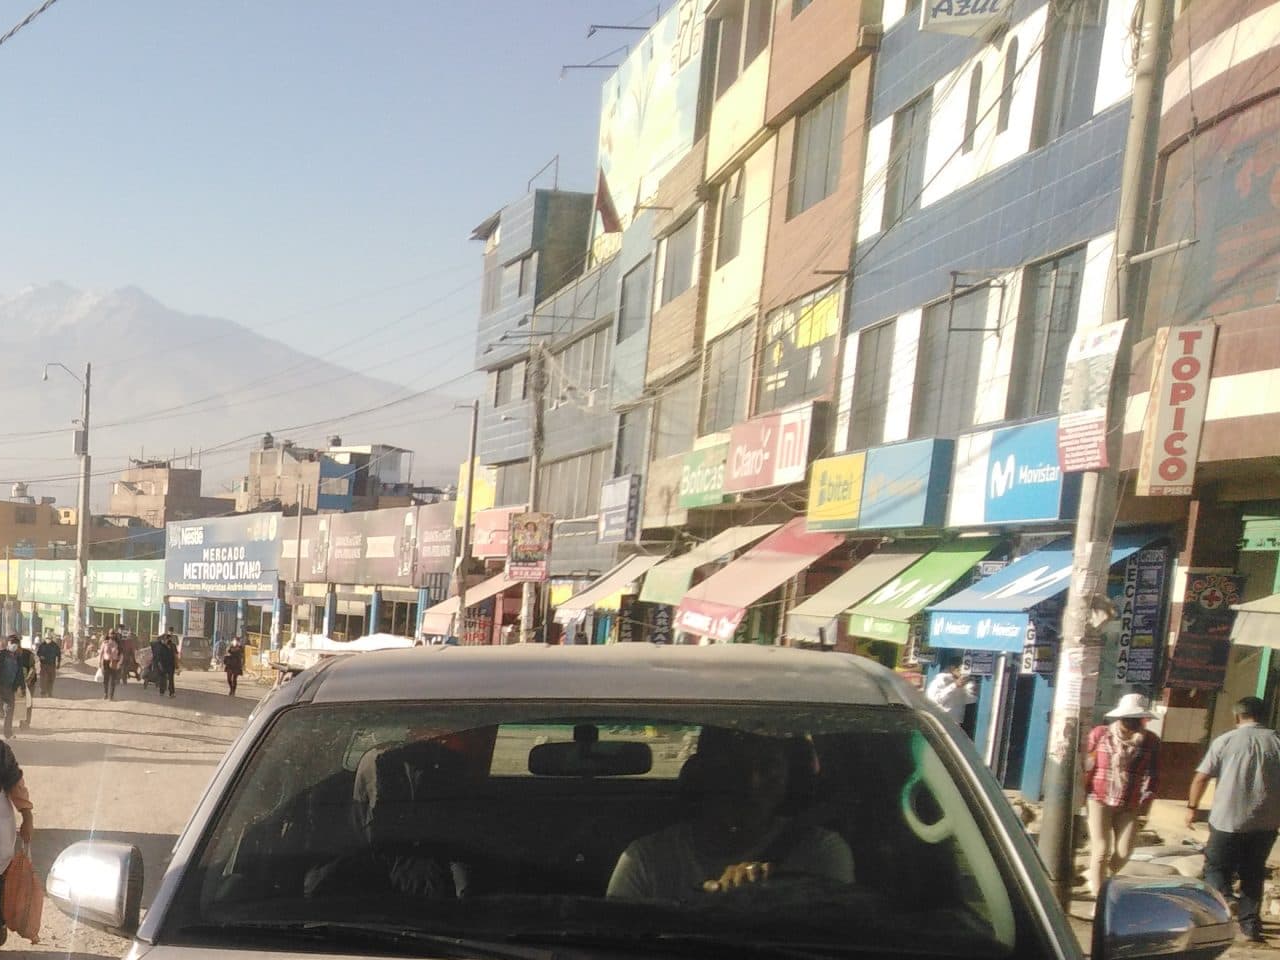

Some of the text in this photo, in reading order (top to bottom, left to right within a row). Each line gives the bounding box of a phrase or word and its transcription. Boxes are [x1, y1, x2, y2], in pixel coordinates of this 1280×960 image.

[1158, 330, 1203, 482] TOPICO
[733, 443, 764, 479] Claro
[1019, 463, 1060, 484] Movistar
[681, 465, 725, 496] Boticas
[1164, 486, 1193, 497] PISO
[202, 546, 246, 562] MERCADO
[183, 561, 262, 580] METROPOLITANO
[1116, 553, 1138, 680] RECARGAS
